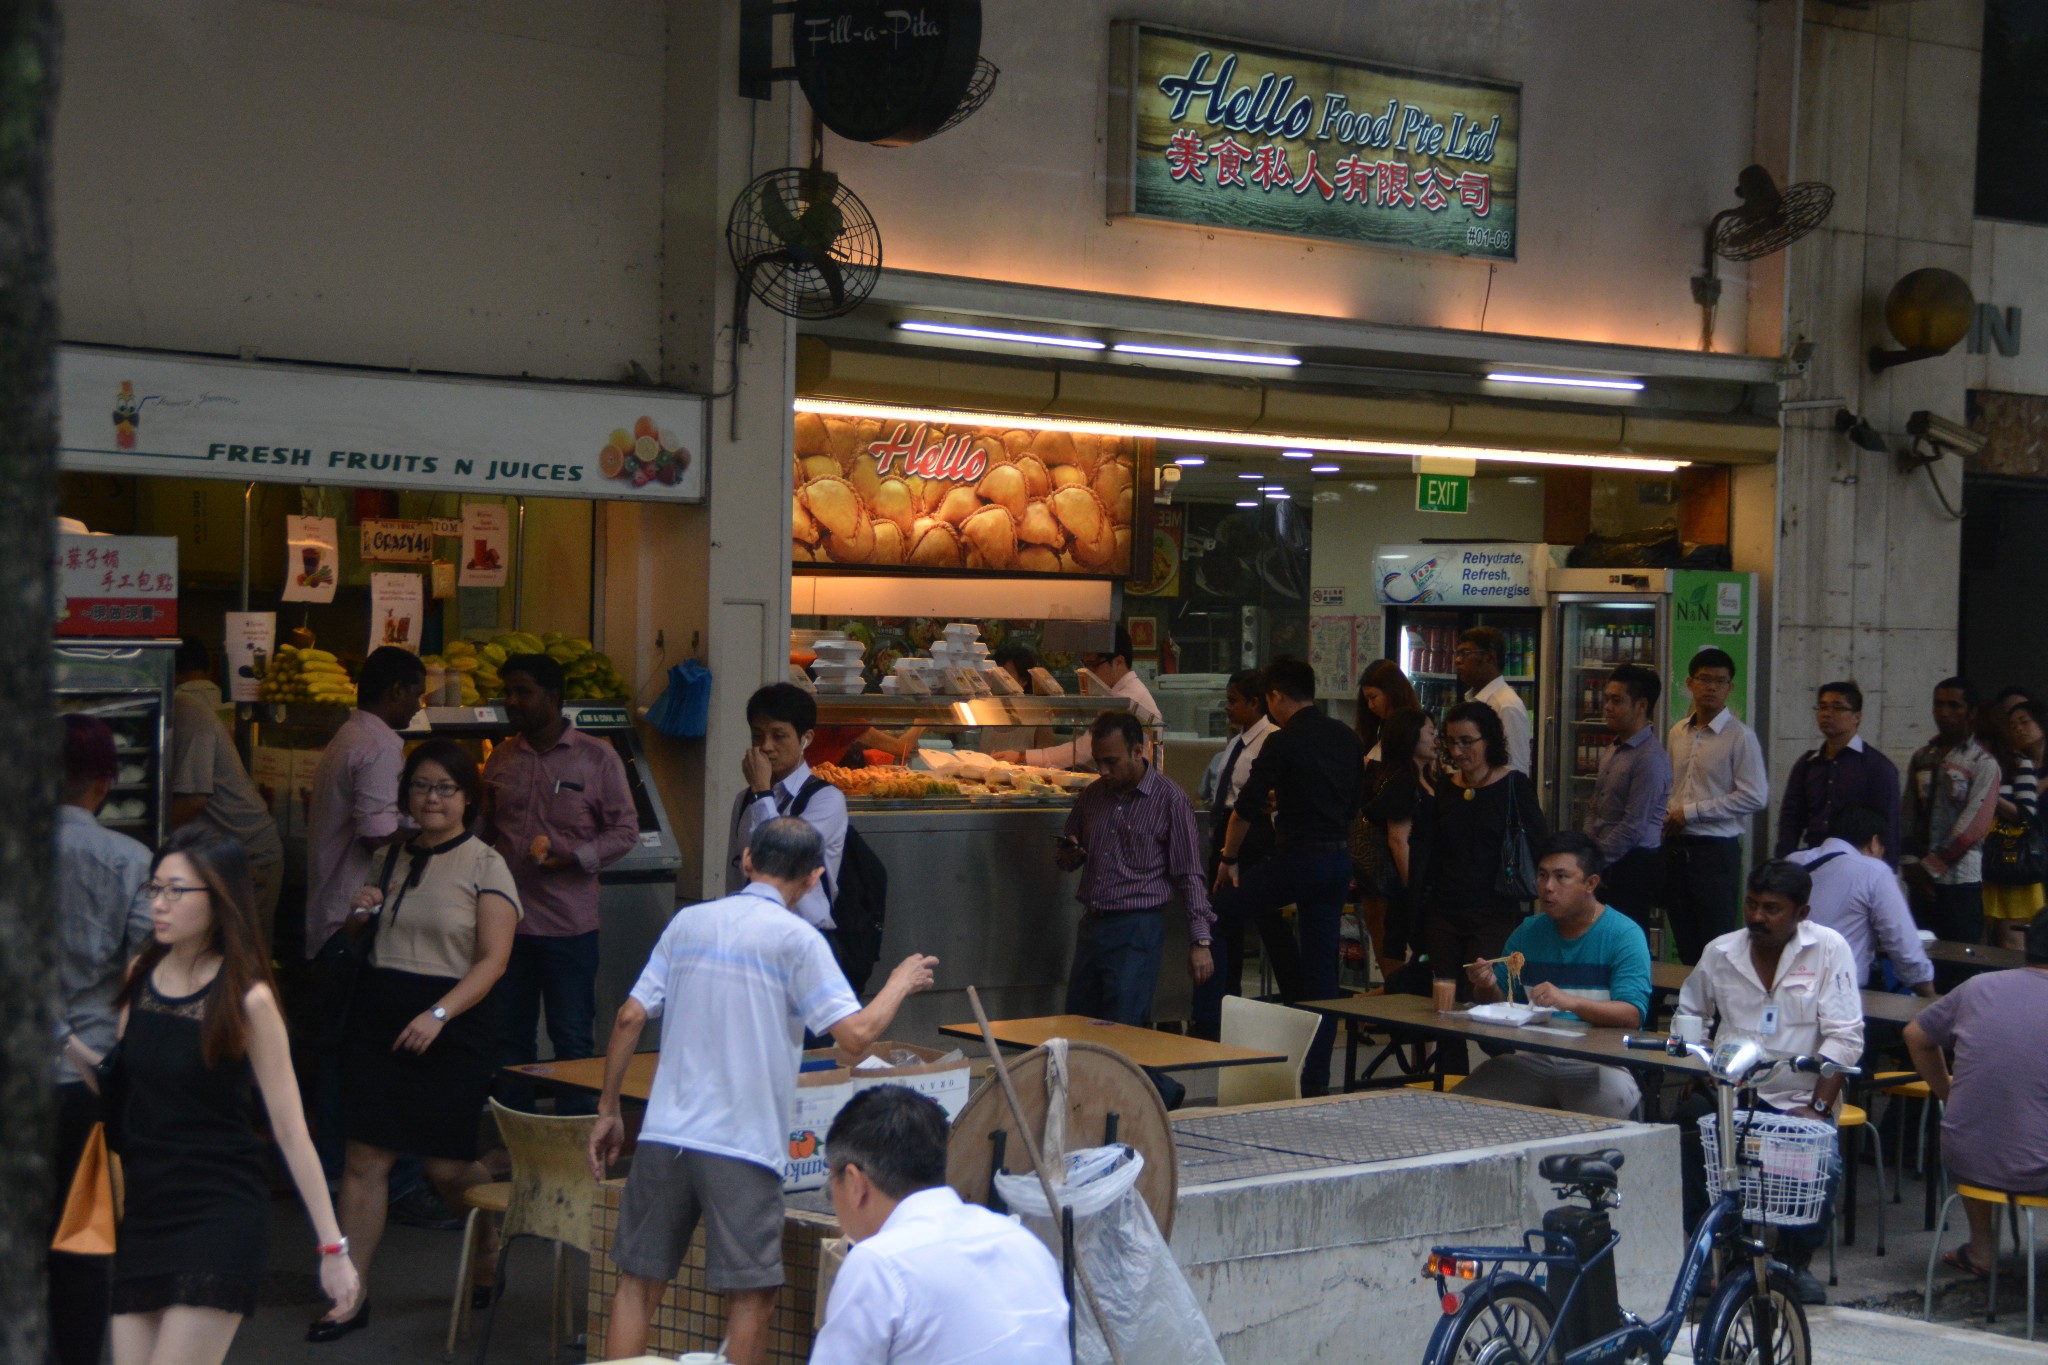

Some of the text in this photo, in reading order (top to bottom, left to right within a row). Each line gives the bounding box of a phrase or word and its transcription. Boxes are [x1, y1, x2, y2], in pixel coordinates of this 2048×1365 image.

[804, 8, 941, 56] Fill-a-Pita
[1158, 50, 1500, 162] Hello Food Pte Ltd
[1165, 127, 1491, 218] 美食私人有限公司
[1467, 226, 1511, 250] #01-03
[208, 443, 583, 482] FRESH FRUITS N JUICES
[868, 422, 987, 482] Hello
[1428, 479, 1459, 506] EXIT
[1462, 552, 1524, 566] Rehydrate,
[1462, 568, 1510, 581] Refresh,
[1462, 583, 1530, 598] Re-energise
